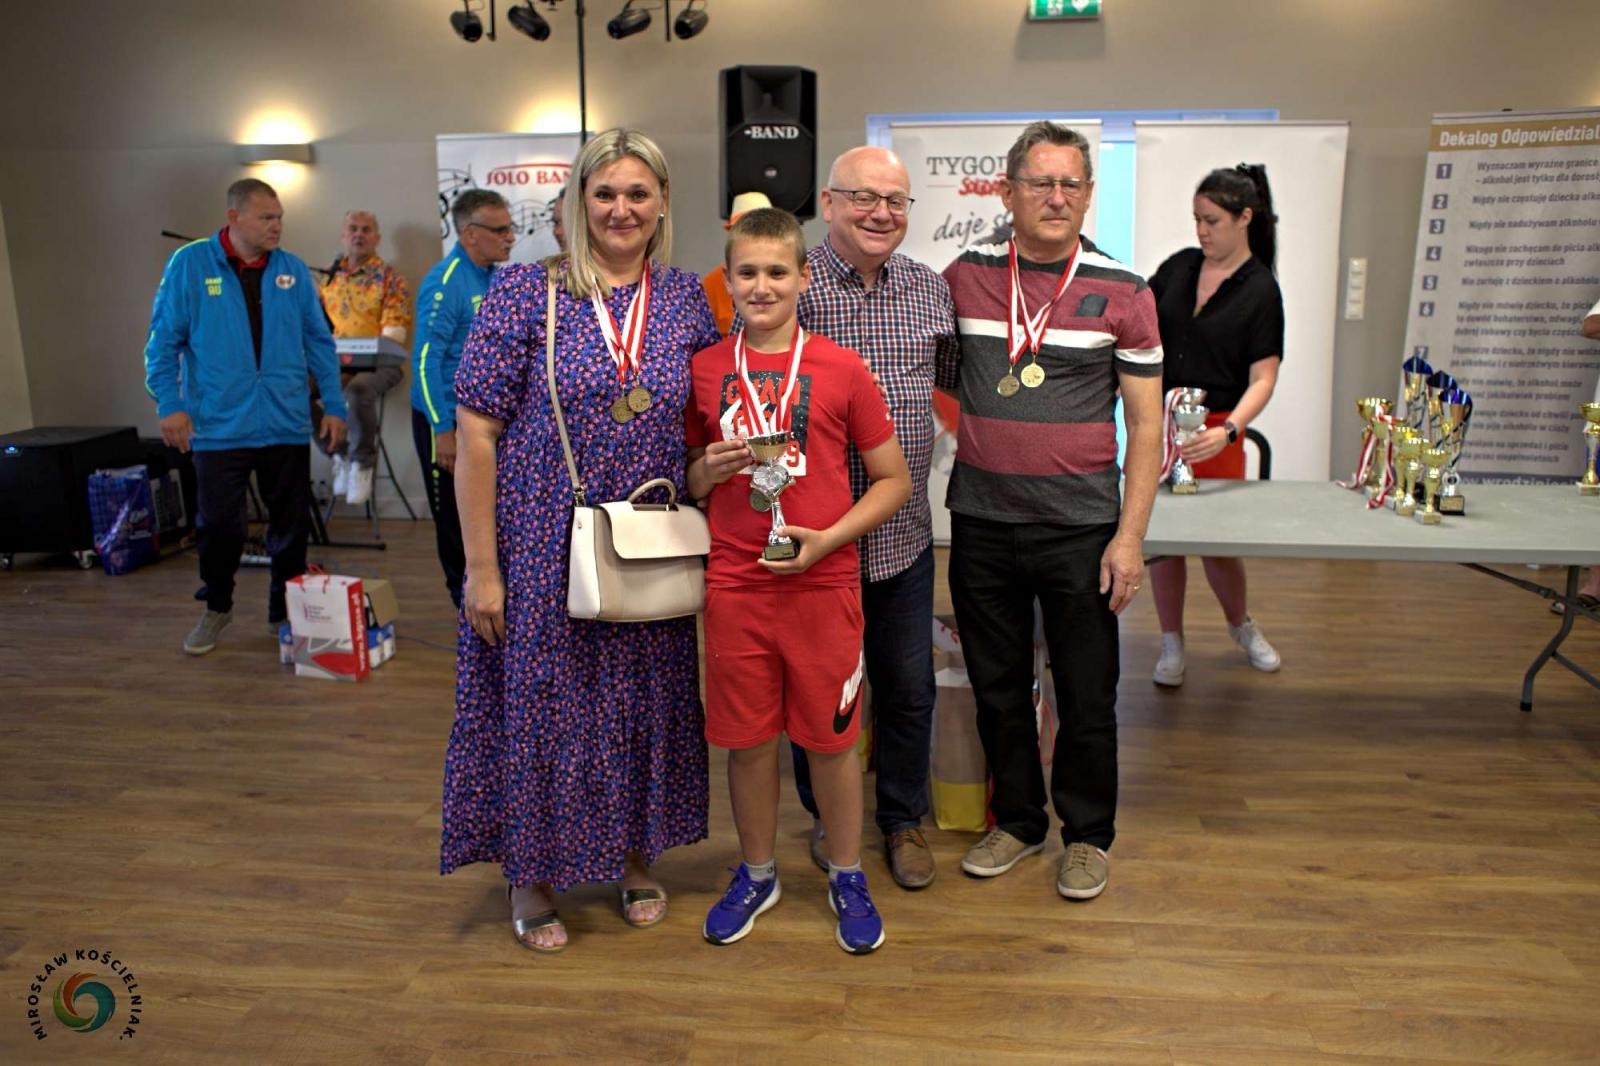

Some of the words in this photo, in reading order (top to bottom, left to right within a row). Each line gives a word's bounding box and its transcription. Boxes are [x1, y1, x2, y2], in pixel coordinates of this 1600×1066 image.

[1440, 131, 1498, 147] Dekalog
[486, 171, 530, 186] SOLO
[933, 211, 988, 248] daje
